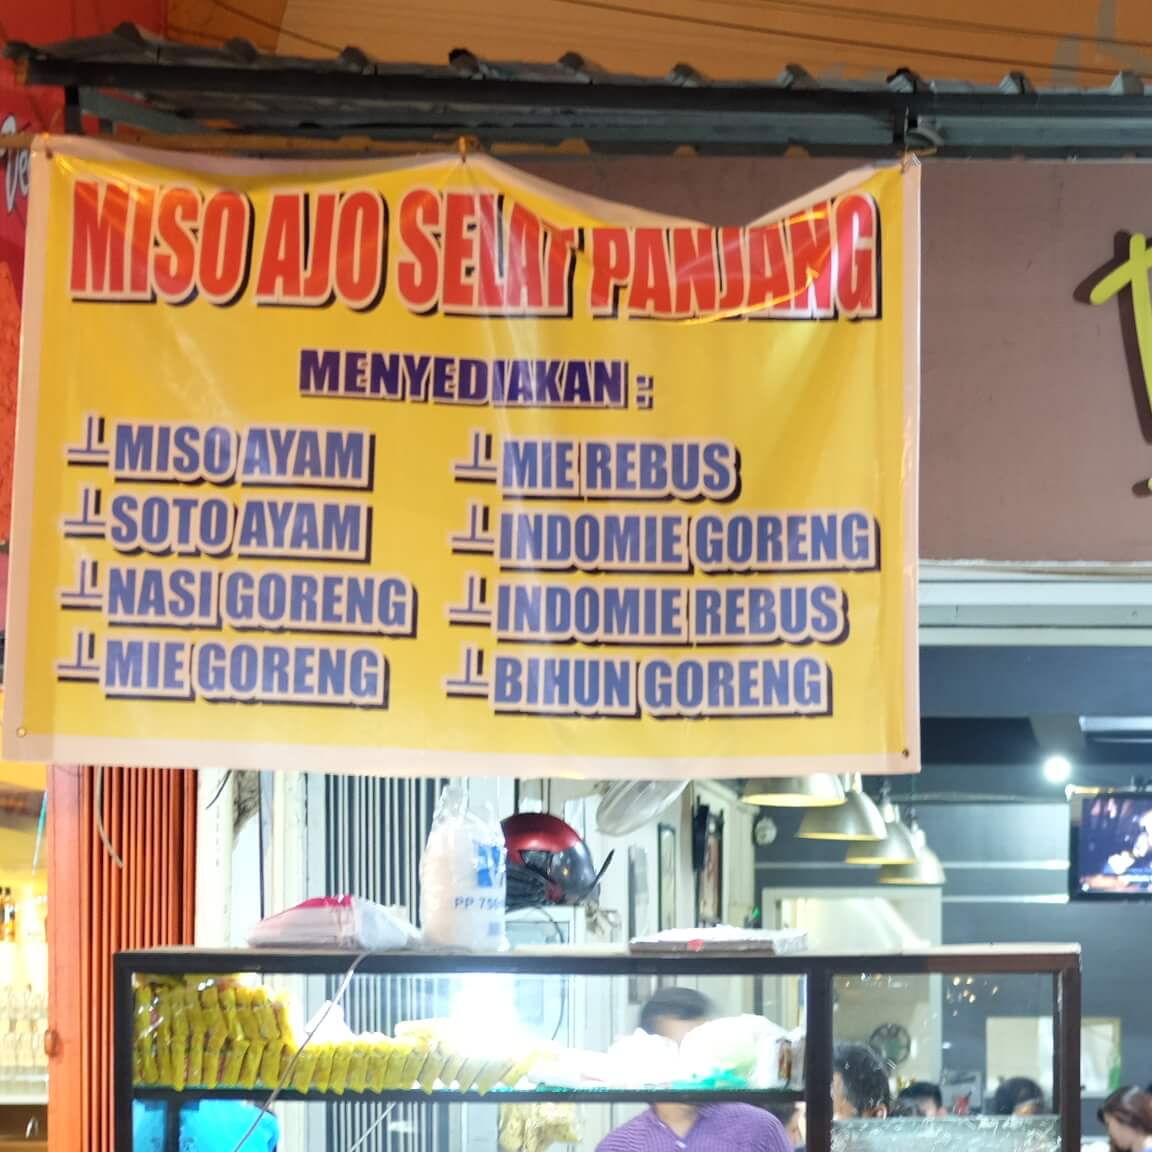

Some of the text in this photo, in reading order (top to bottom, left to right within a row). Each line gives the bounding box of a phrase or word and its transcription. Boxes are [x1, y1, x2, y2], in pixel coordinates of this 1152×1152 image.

[68, 178, 883, 323] MISO AJO SELAT PANJANG
[111, 423, 374, 492] MISO AYAM
[500, 440, 741, 501] MIE REBUS
[110, 495, 370, 561] SOTO AYAM
[497, 510, 881, 575] INDOMIE GORENG
[106, 567, 416, 637] NASI GORENG
[496, 582, 849, 644] INDOMIE REBUS
[102, 637, 389, 707] MIE GORENG
[493, 655, 832, 718] BIHUN GORENG
